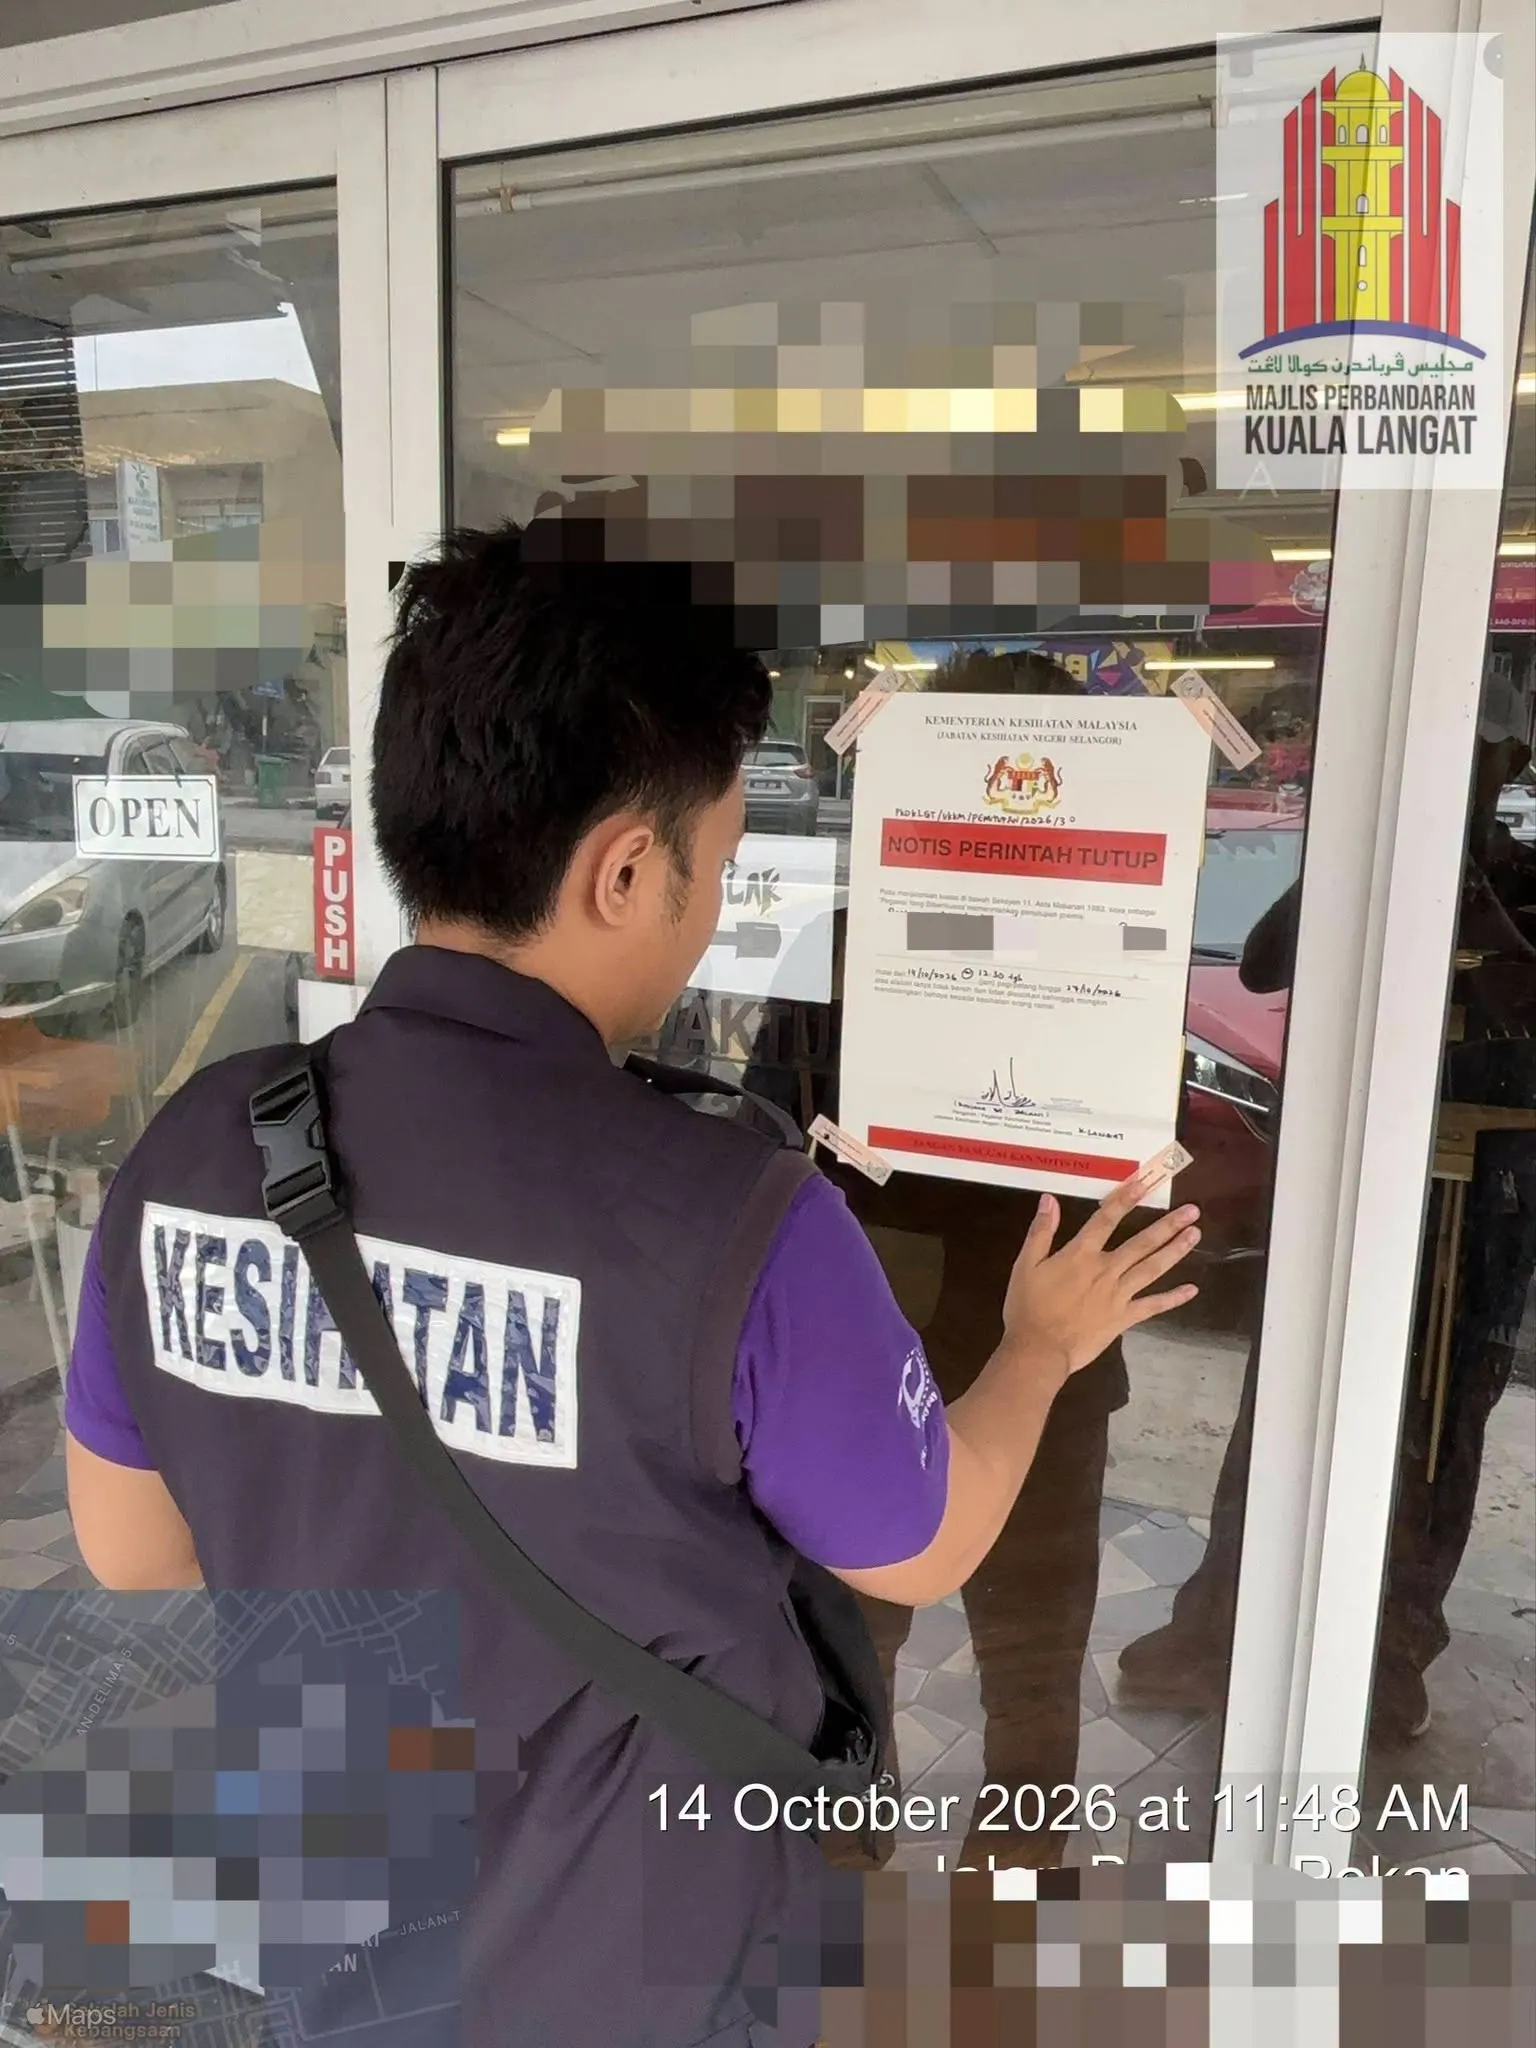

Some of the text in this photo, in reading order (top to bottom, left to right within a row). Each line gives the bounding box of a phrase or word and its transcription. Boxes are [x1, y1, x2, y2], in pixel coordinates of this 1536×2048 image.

[924, 715, 1138, 731] KEMENTERIAN KESIHATAN MALAYSIA
[980, 732, 1030, 743] KESIHATAN
[1033, 734, 1067, 744] NEGERI
[88, 796, 202, 839] OPEN
[887, 836, 1160, 870] NOTIS PERINTAH TUTUP
[322, 835, 350, 971] PUSH
[726, 866, 783, 916] LAK
[153, 1224, 561, 1442] KESIHTAN
